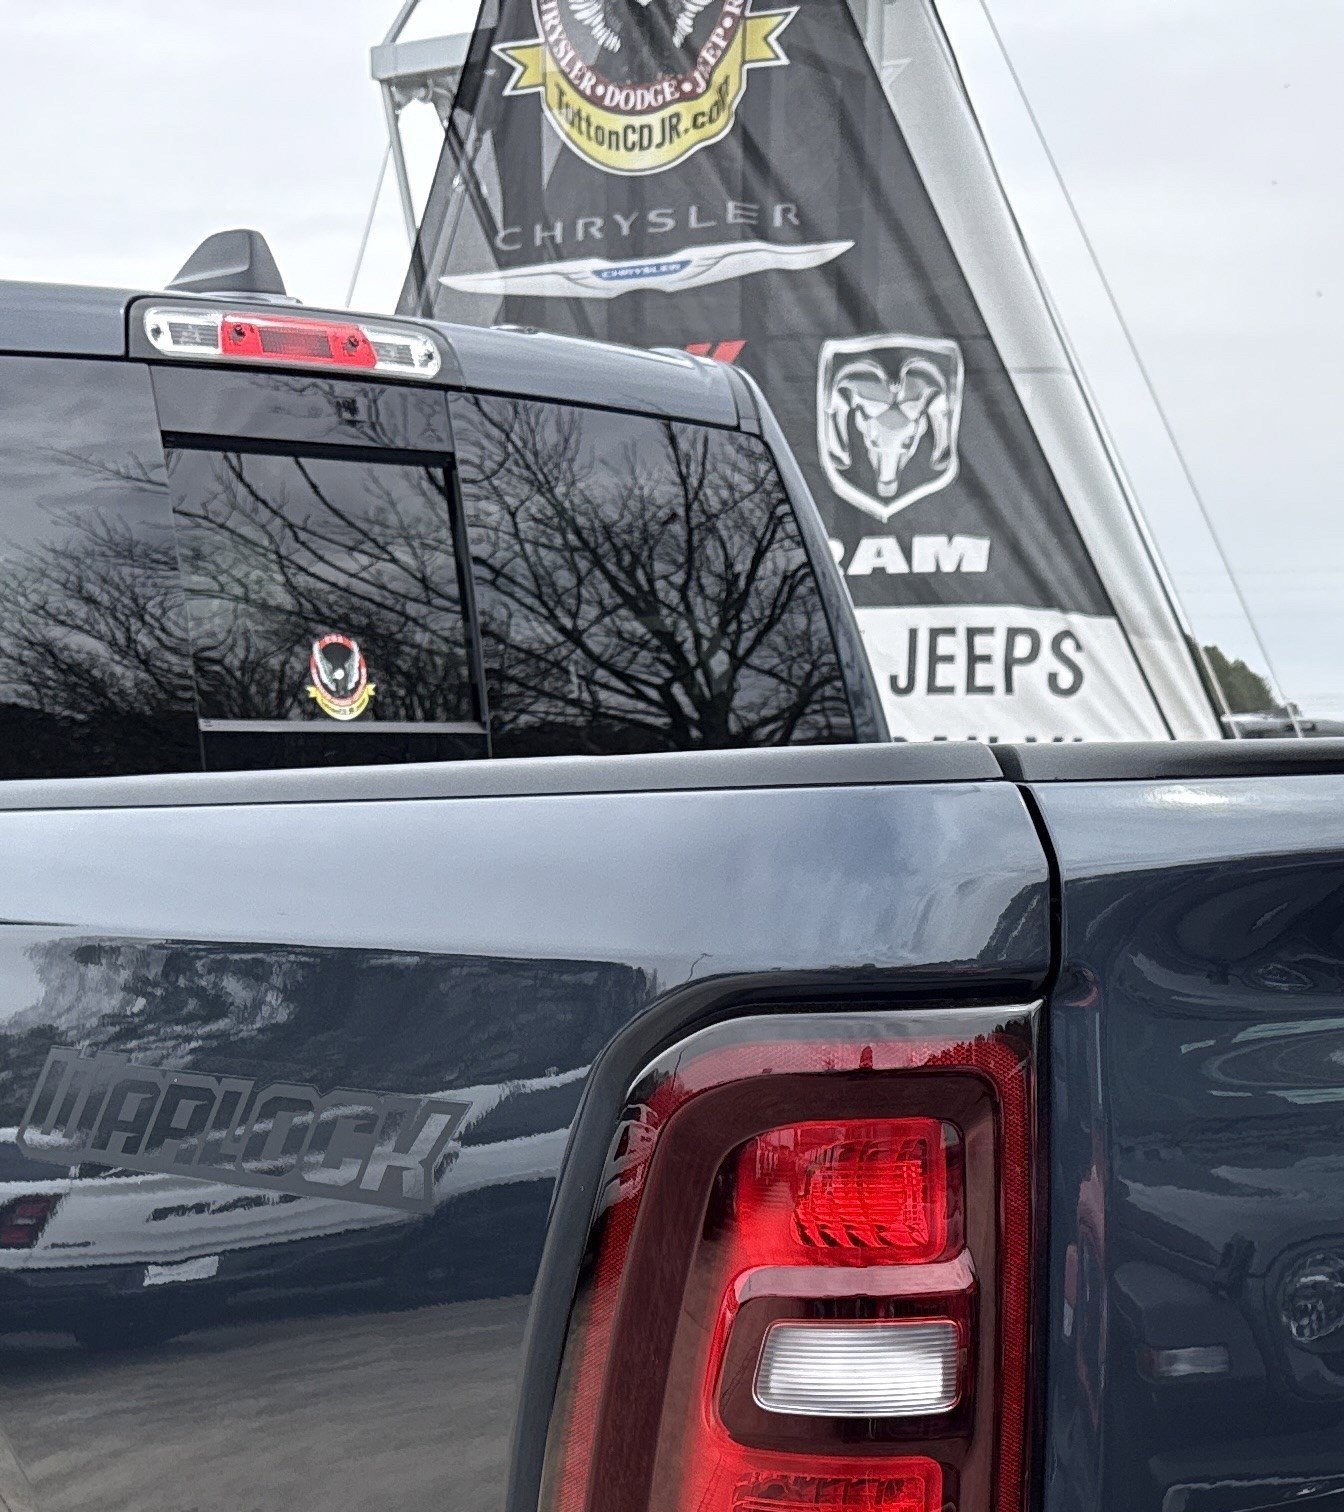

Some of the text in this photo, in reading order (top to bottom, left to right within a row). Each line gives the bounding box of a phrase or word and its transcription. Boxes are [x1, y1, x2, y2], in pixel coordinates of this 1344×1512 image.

[541, 0, 727, 111] RYSLER DODGE JEEP
[496, 202, 800, 251] CHRYSLER
[601, 263, 681, 278] CHRYSLER
[890, 627, 1084, 698] JEEPS
[18, 1046, 472, 1214] WARLOCK
